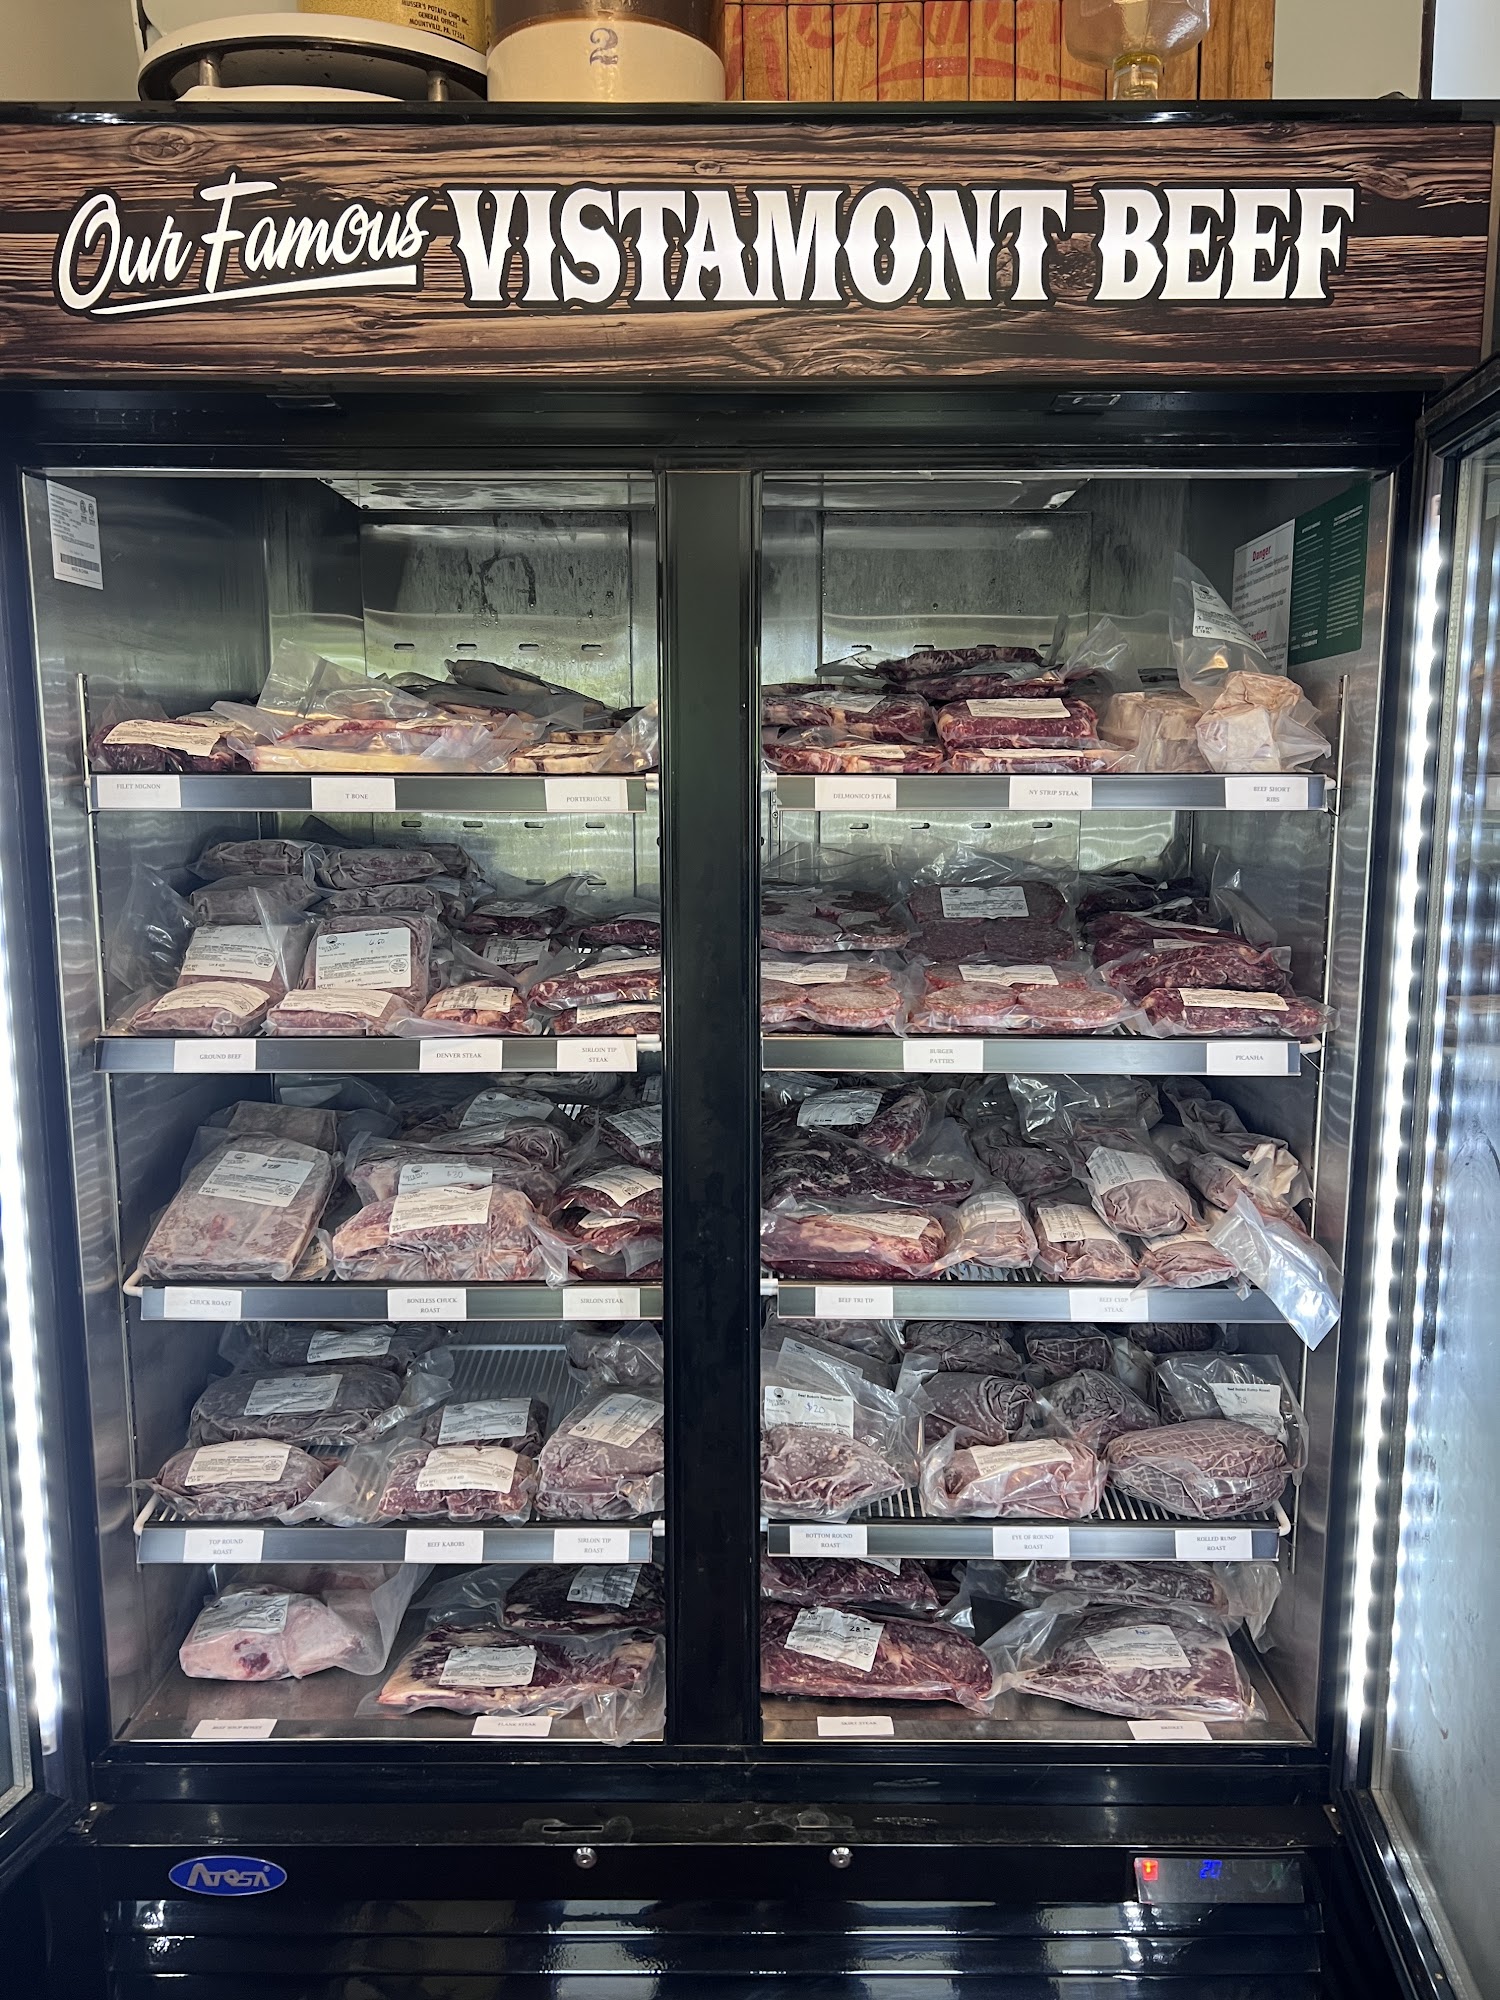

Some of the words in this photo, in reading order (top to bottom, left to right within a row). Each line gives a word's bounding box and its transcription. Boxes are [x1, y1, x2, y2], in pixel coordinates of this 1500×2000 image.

[428, 5, 447, 16] POTATO
[418, 11, 440, 22] GENERAL
[441, 17, 458, 28] OFFICES
[589, 27, 619, 65] 2
[60, 193, 193, 309] Our
[200, 172, 430, 294] Famous
[446, 187, 1067, 303] VISTAMONT
[1094, 187, 1355, 301] BEEF
[1252, 545, 1271, 561] Danger
[805, 1402, 825, 1413] $20
[1199, 1859, 1223, 1880] 20
